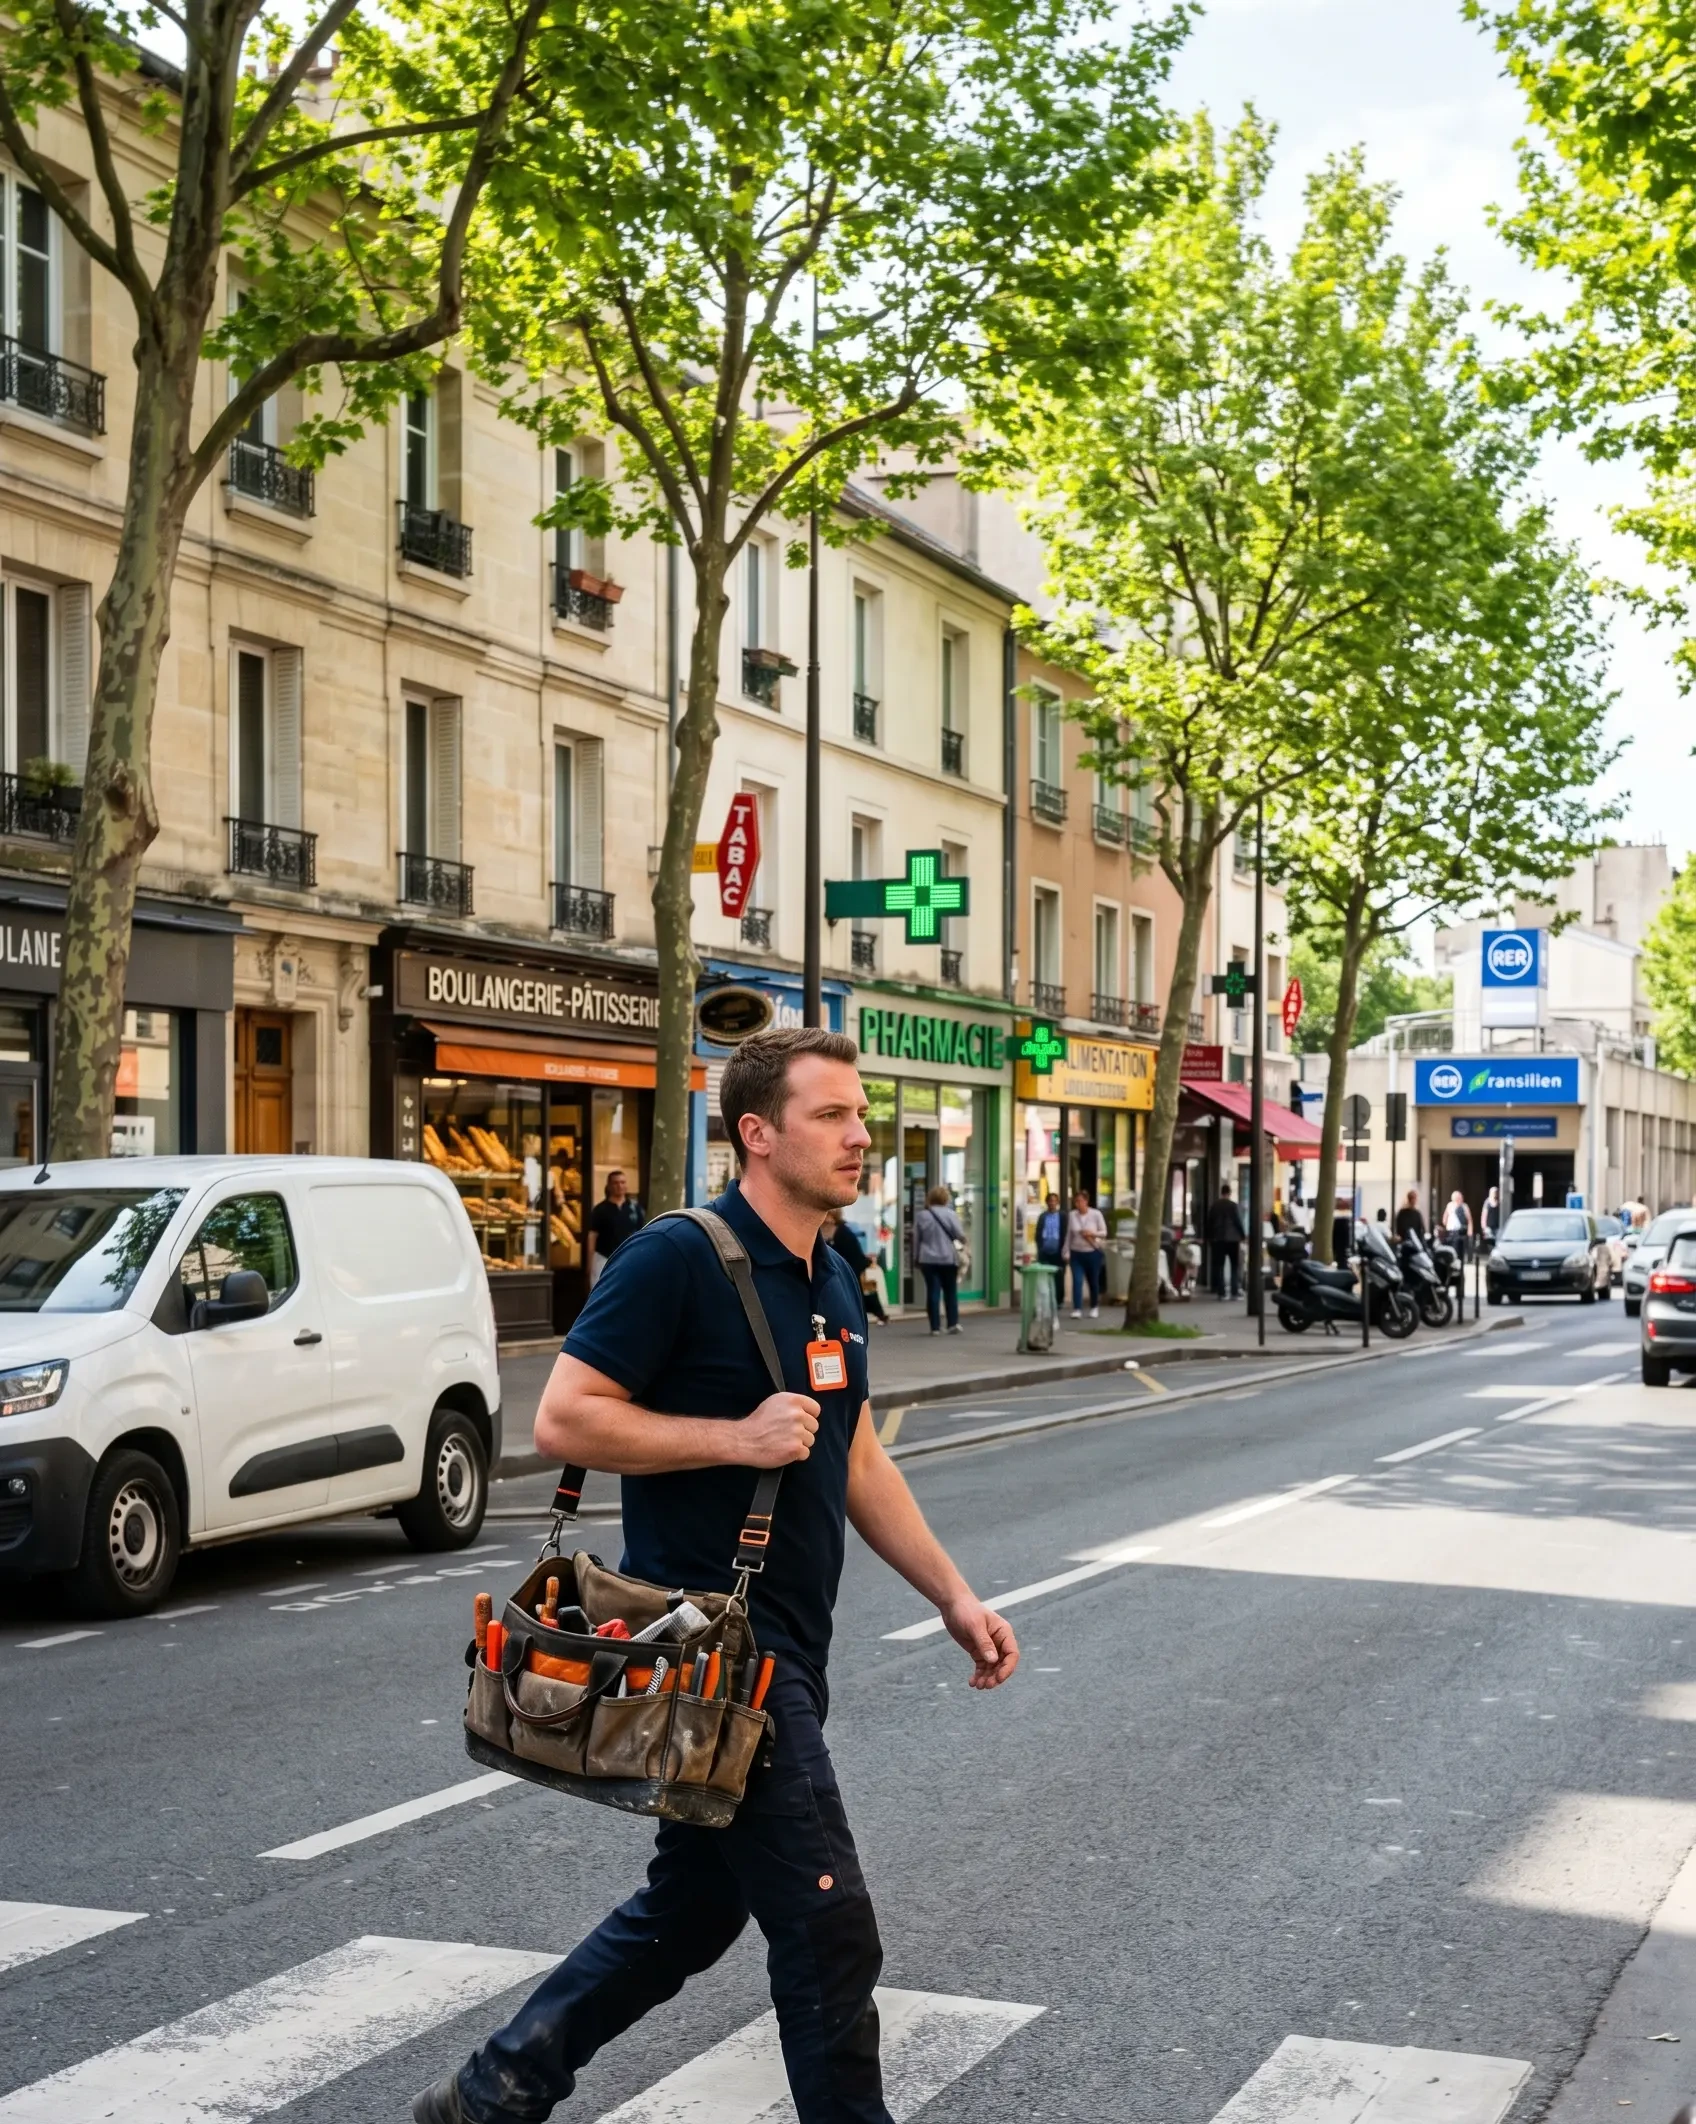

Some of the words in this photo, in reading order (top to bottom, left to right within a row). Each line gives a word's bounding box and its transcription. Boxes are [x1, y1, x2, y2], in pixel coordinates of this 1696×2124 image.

[723, 806, 751, 905] TABAC
[1493, 949, 1528, 967] RER
[859, 1007, 1003, 1070] PHARMACIE
